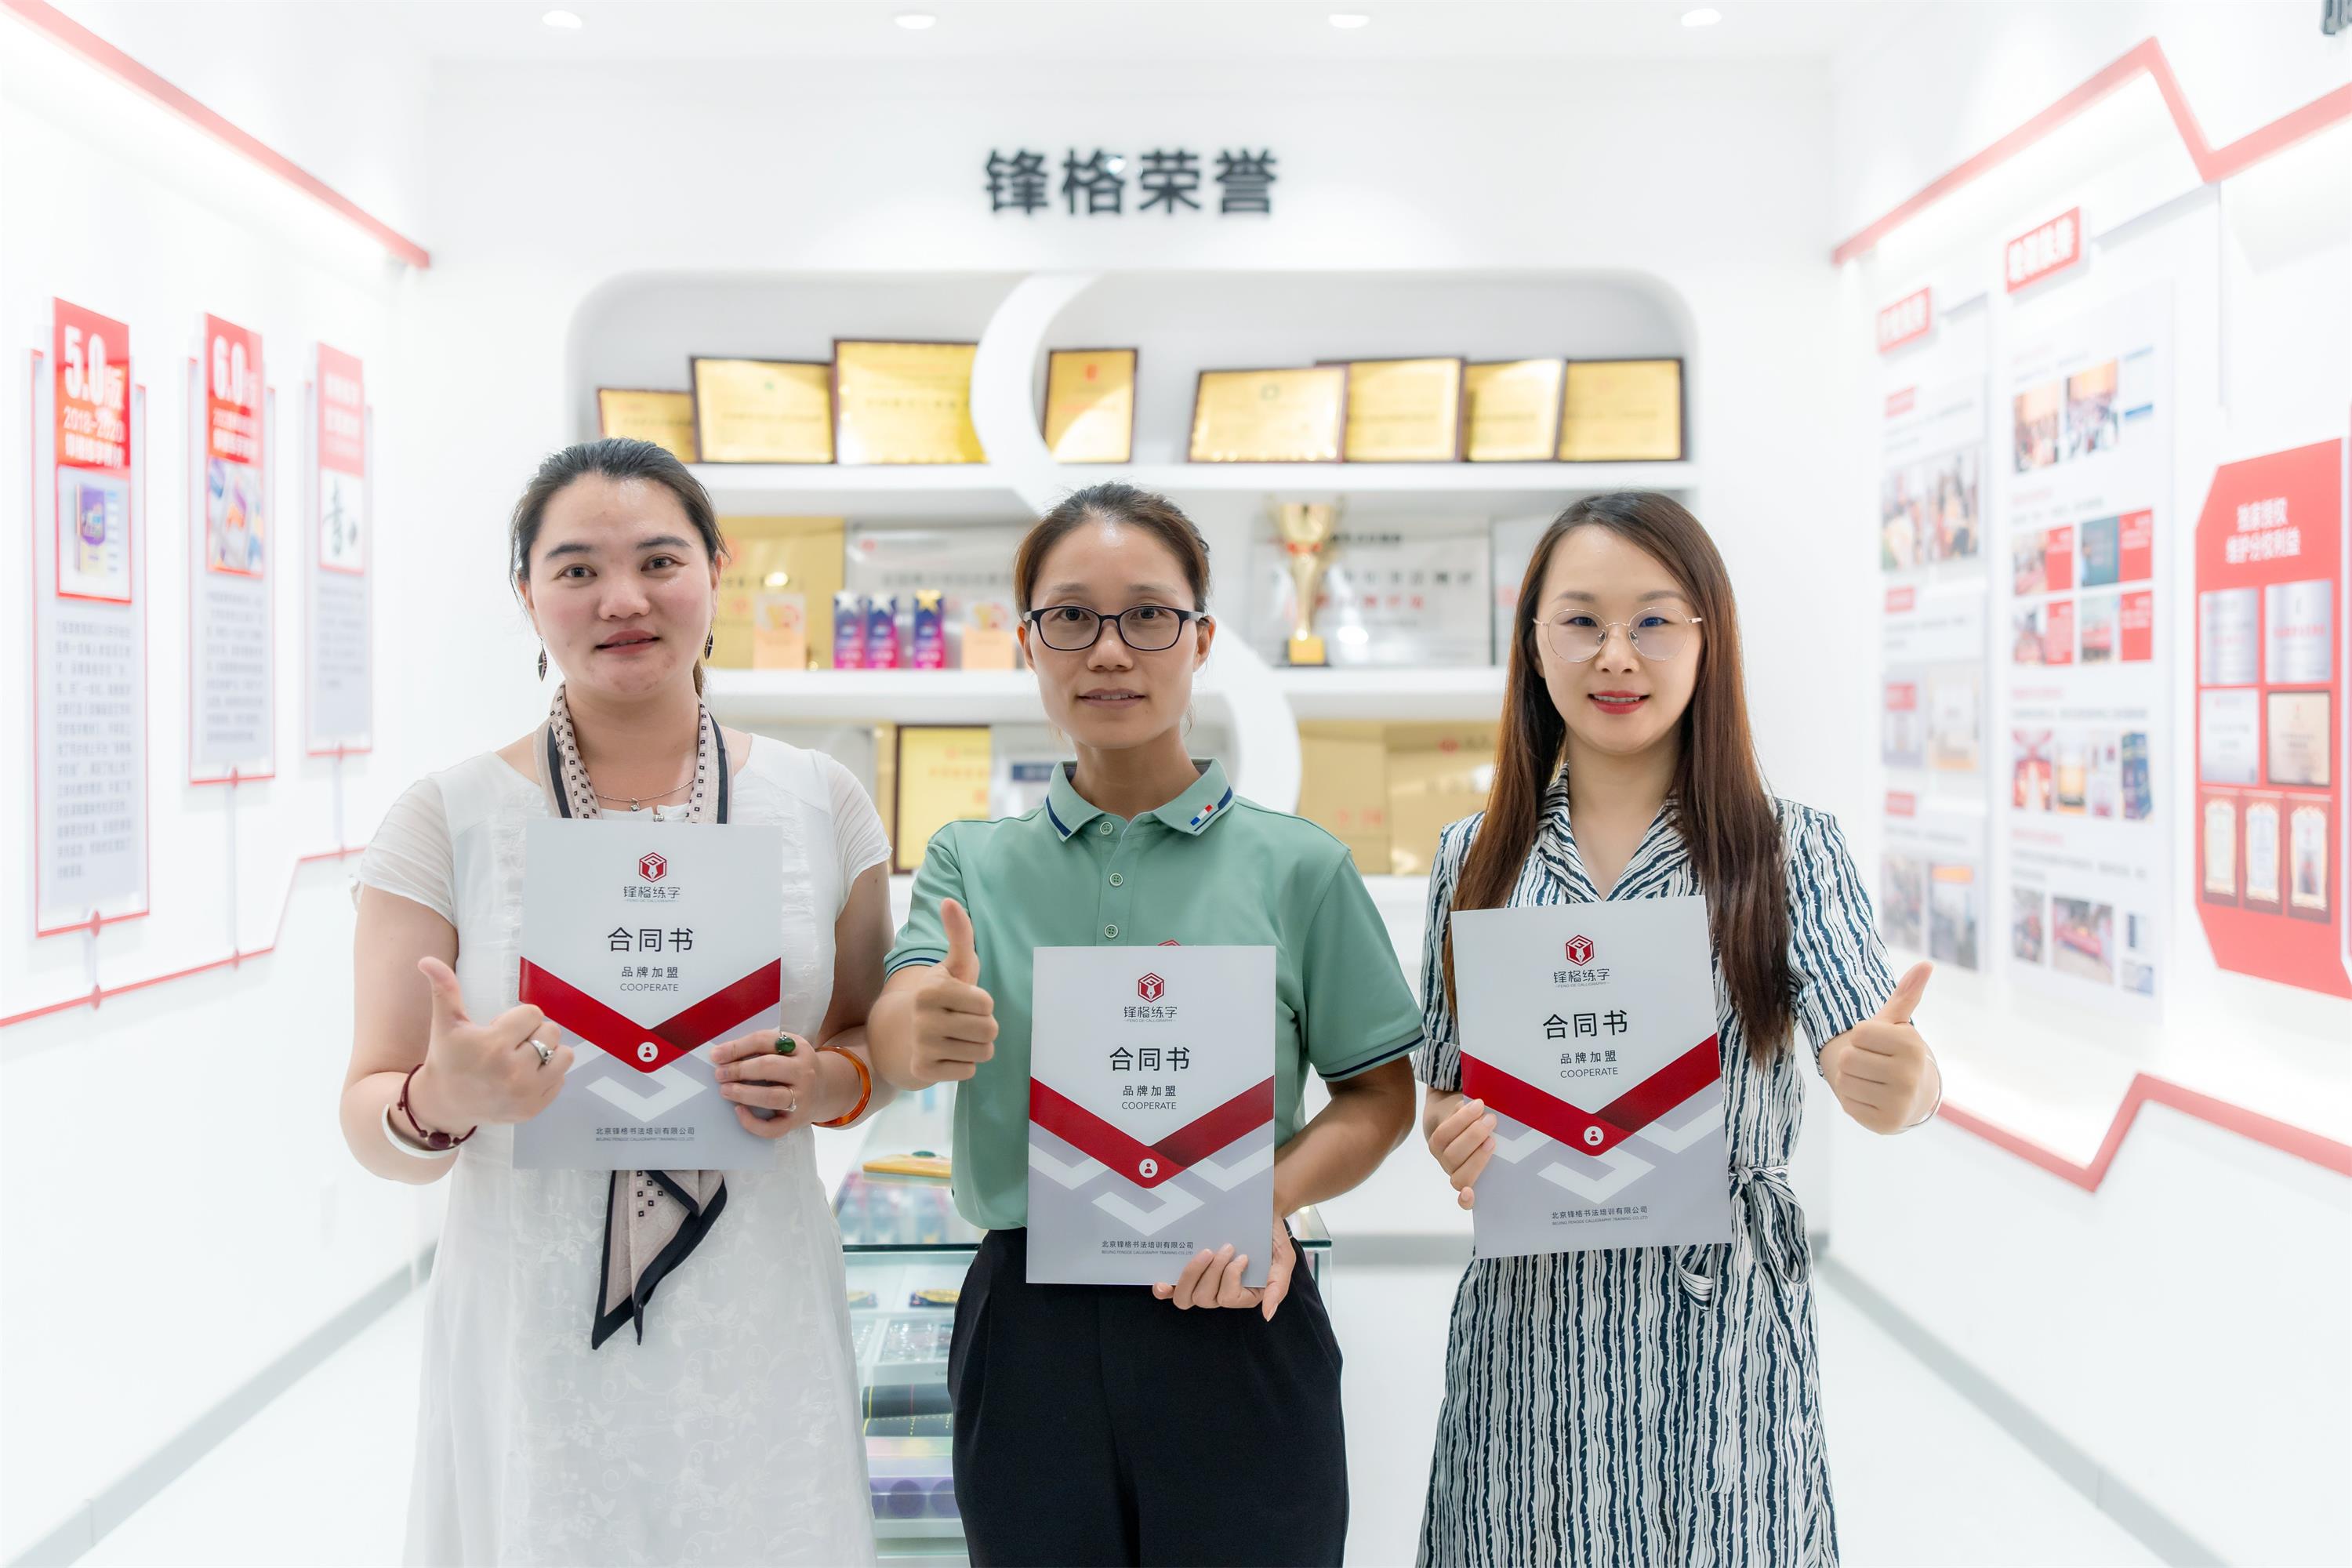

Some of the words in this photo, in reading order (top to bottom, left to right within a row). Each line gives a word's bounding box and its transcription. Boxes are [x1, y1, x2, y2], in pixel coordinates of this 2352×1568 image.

[985, 148, 1277, 216] 锋格荣誉
[623, 886, 681, 899] 锋格练字
[608, 927, 694, 953] 合同书
[621, 966, 678, 978] 品牌加盟
[1553, 968, 1610, 984] 锋格练字
[620, 983, 679, 992] COOPERATE
[1123, 1006, 1178, 1018] 锋格练字
[1543, 1009, 1628, 1040] 合同书
[1109, 1047, 1190, 1072] 合同书
[1560, 1050, 1617, 1065] 品牌加盟
[1560, 1067, 1619, 1079] COOPERATE
[1123, 1085, 1176, 1097] 品牌加盟
[1121, 1102, 1177, 1110] COOPERATE
[595, 1127, 695, 1135] 北京锋格书法培训有限公司
[1552, 1206, 1648, 1220] 北京锋格书法培训有限公司
[1102, 1240, 1194, 1249] 北京锋格书法培训有限公司
